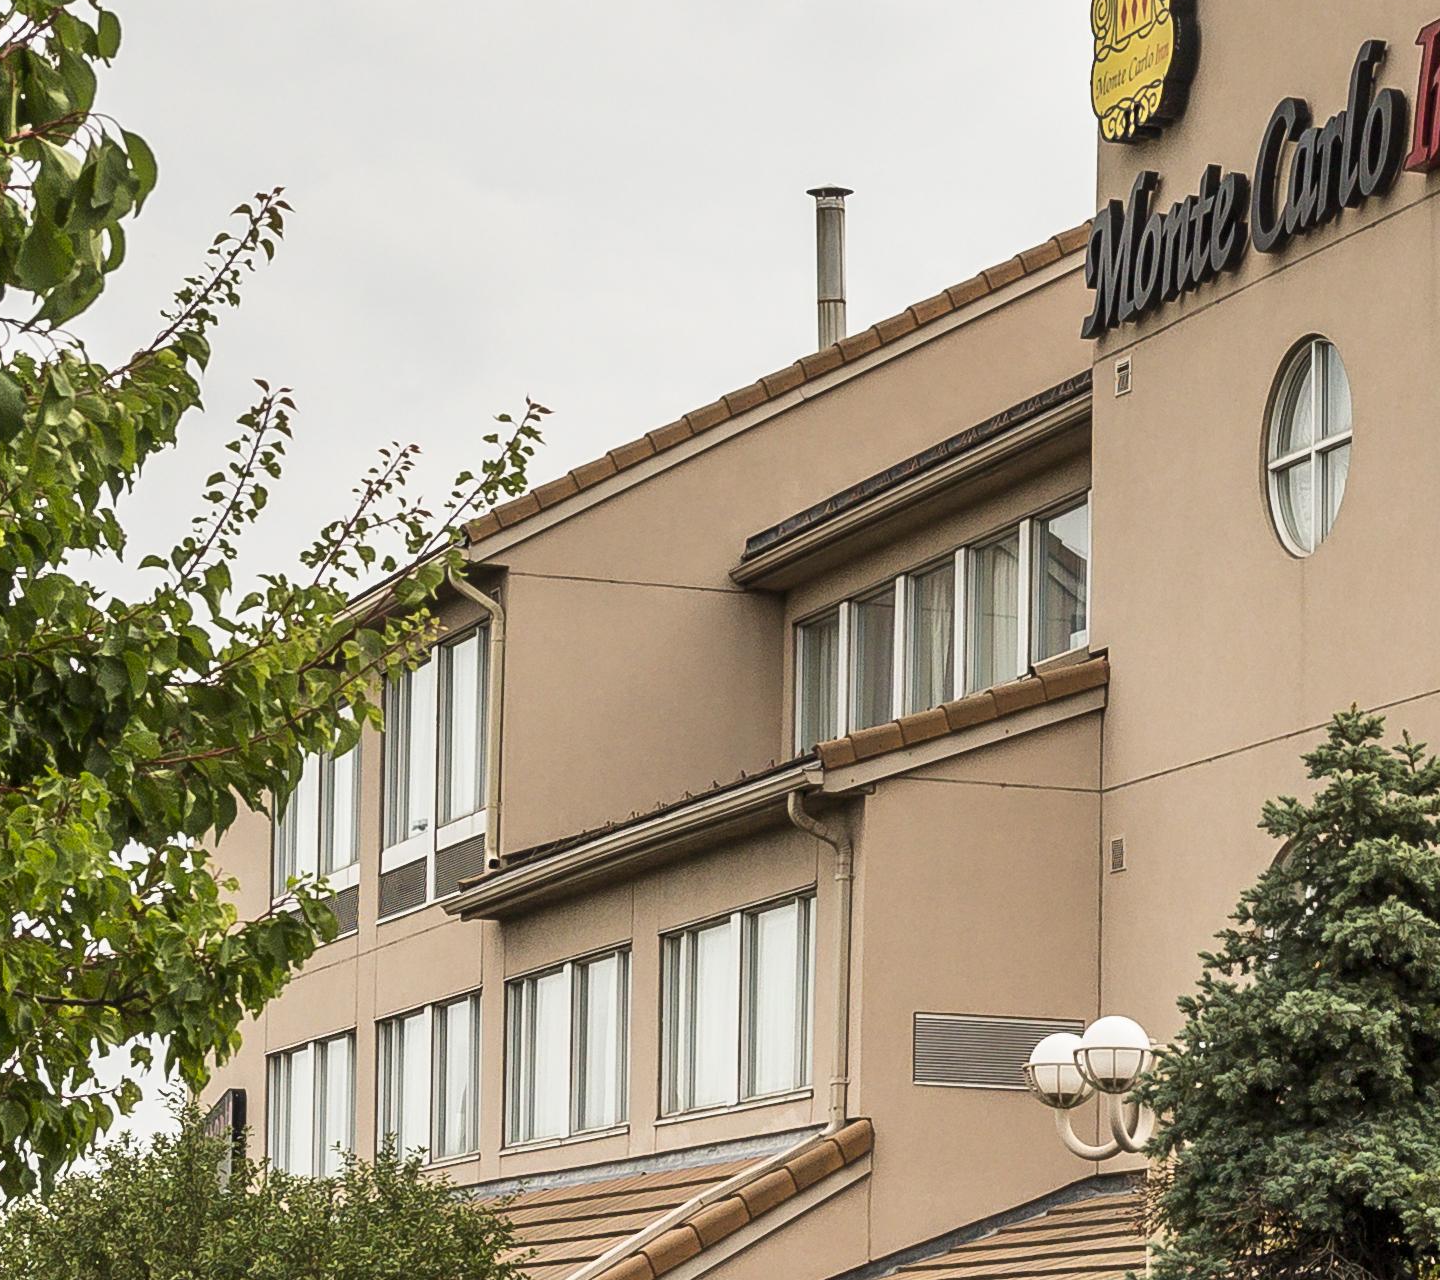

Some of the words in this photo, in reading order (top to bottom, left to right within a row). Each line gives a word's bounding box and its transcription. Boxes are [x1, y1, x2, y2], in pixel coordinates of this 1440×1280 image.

[1095, 67, 1127, 101] Monte
[1128, 45, 1155, 82] Carlo
[1081, 164, 1250, 339] Monte
[1251, 39, 1406, 253] Carlo
